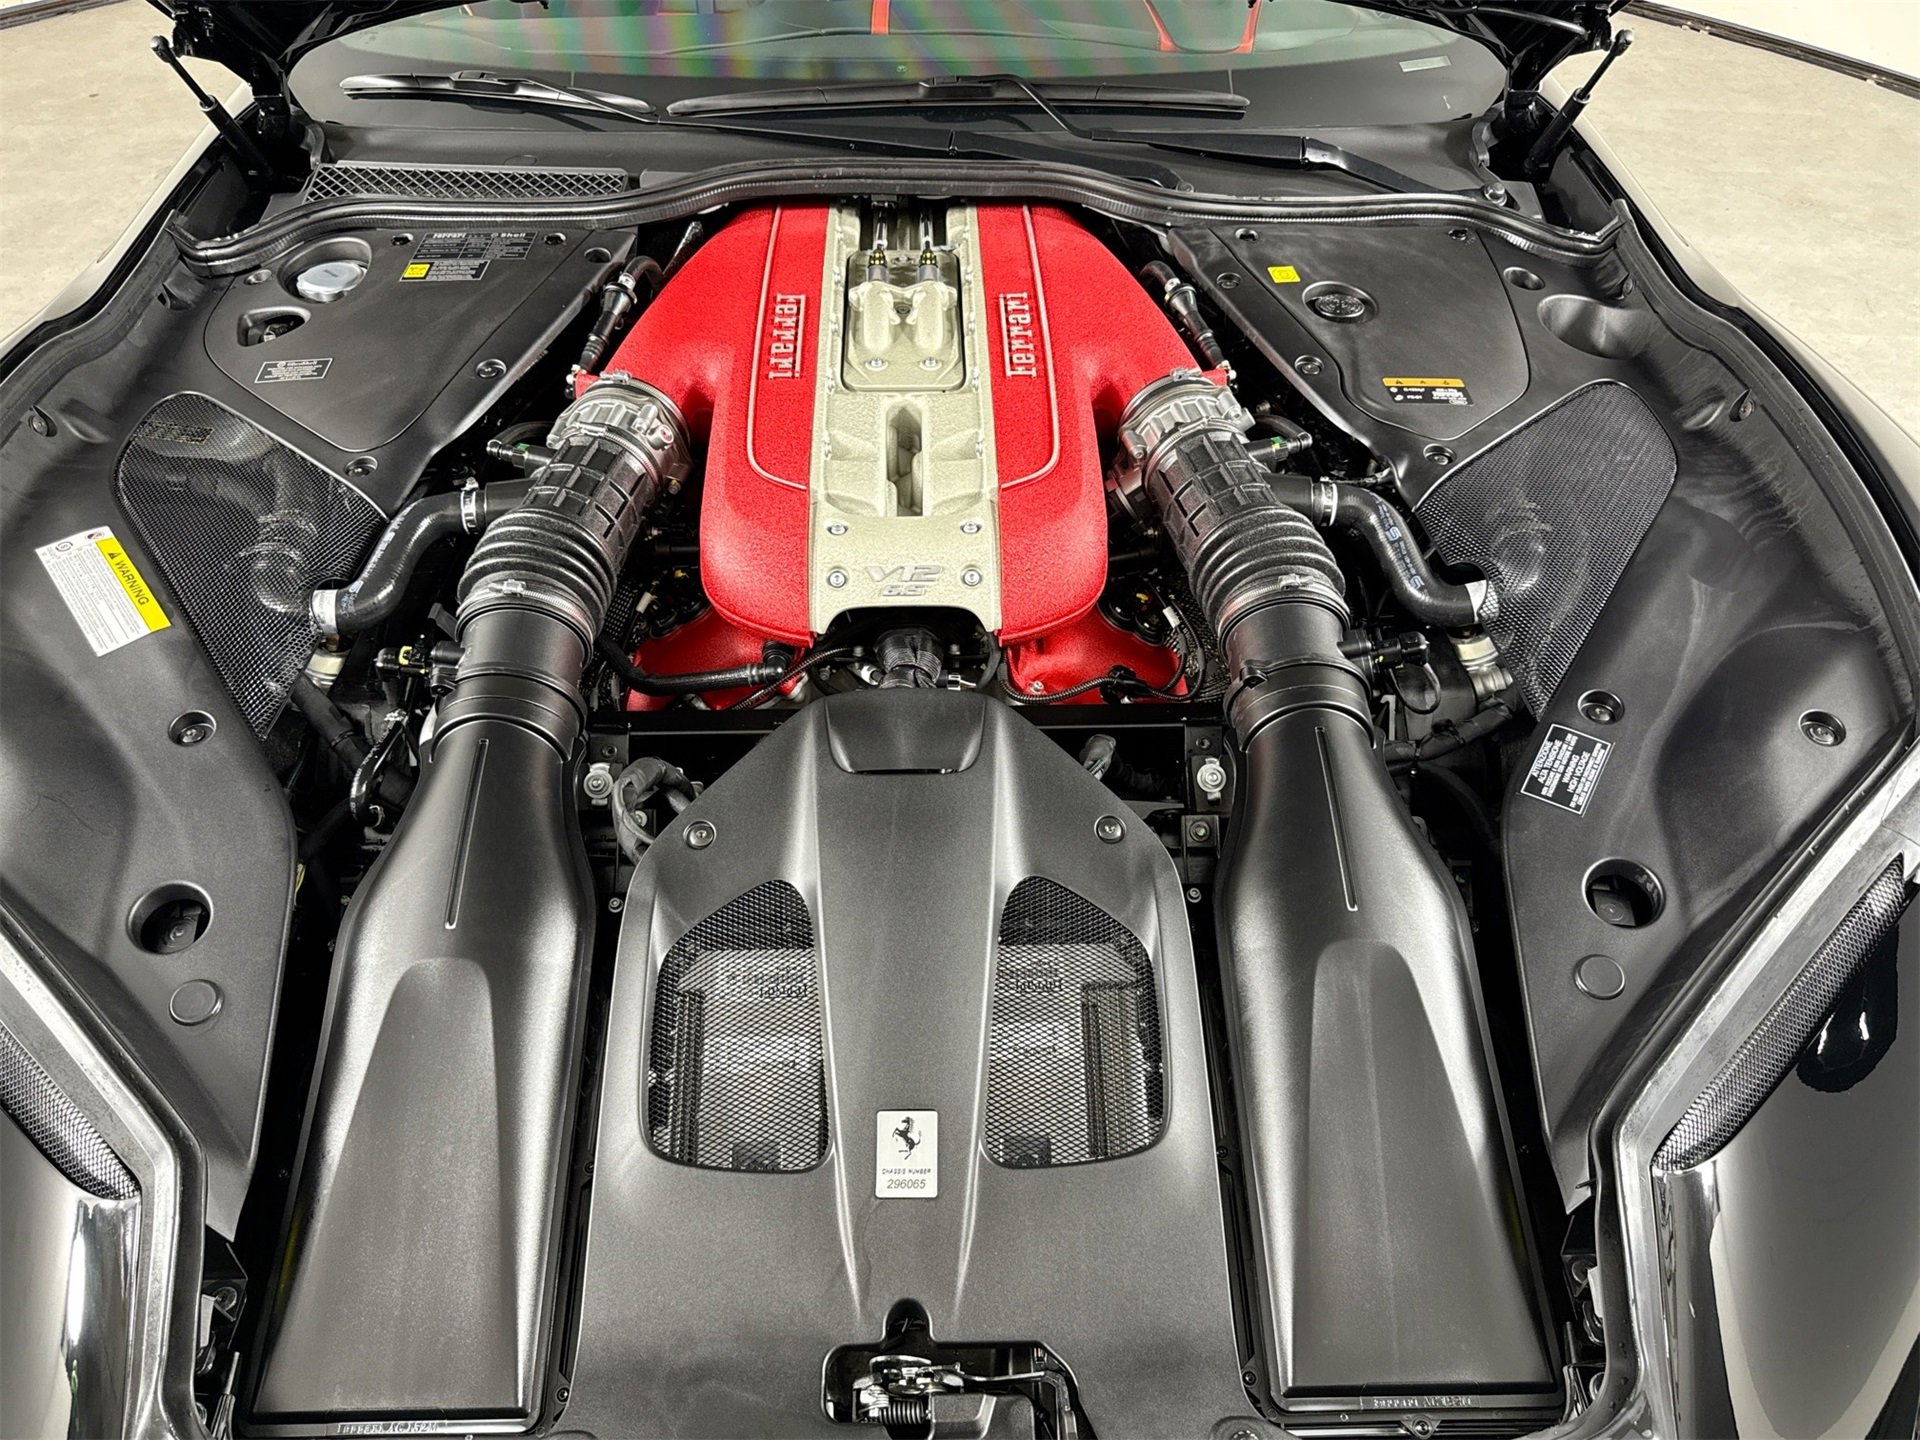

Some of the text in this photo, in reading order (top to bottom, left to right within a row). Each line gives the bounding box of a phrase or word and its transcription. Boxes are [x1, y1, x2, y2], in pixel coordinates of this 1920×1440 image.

[767, 292, 806, 379] Ferrari
[999, 291, 1038, 378] Ferrari
[115, 559, 150, 606] WARNING
[865, 564, 944, 582] V12
[1537, 767, 1548, 783] ALTA
[1561, 754, 1579, 784] WARNING
[1566, 776, 1579, 793] HIGH
[1573, 750, 1590, 777] VOLTAGE
[886, 1178, 927, 1189] 296065
